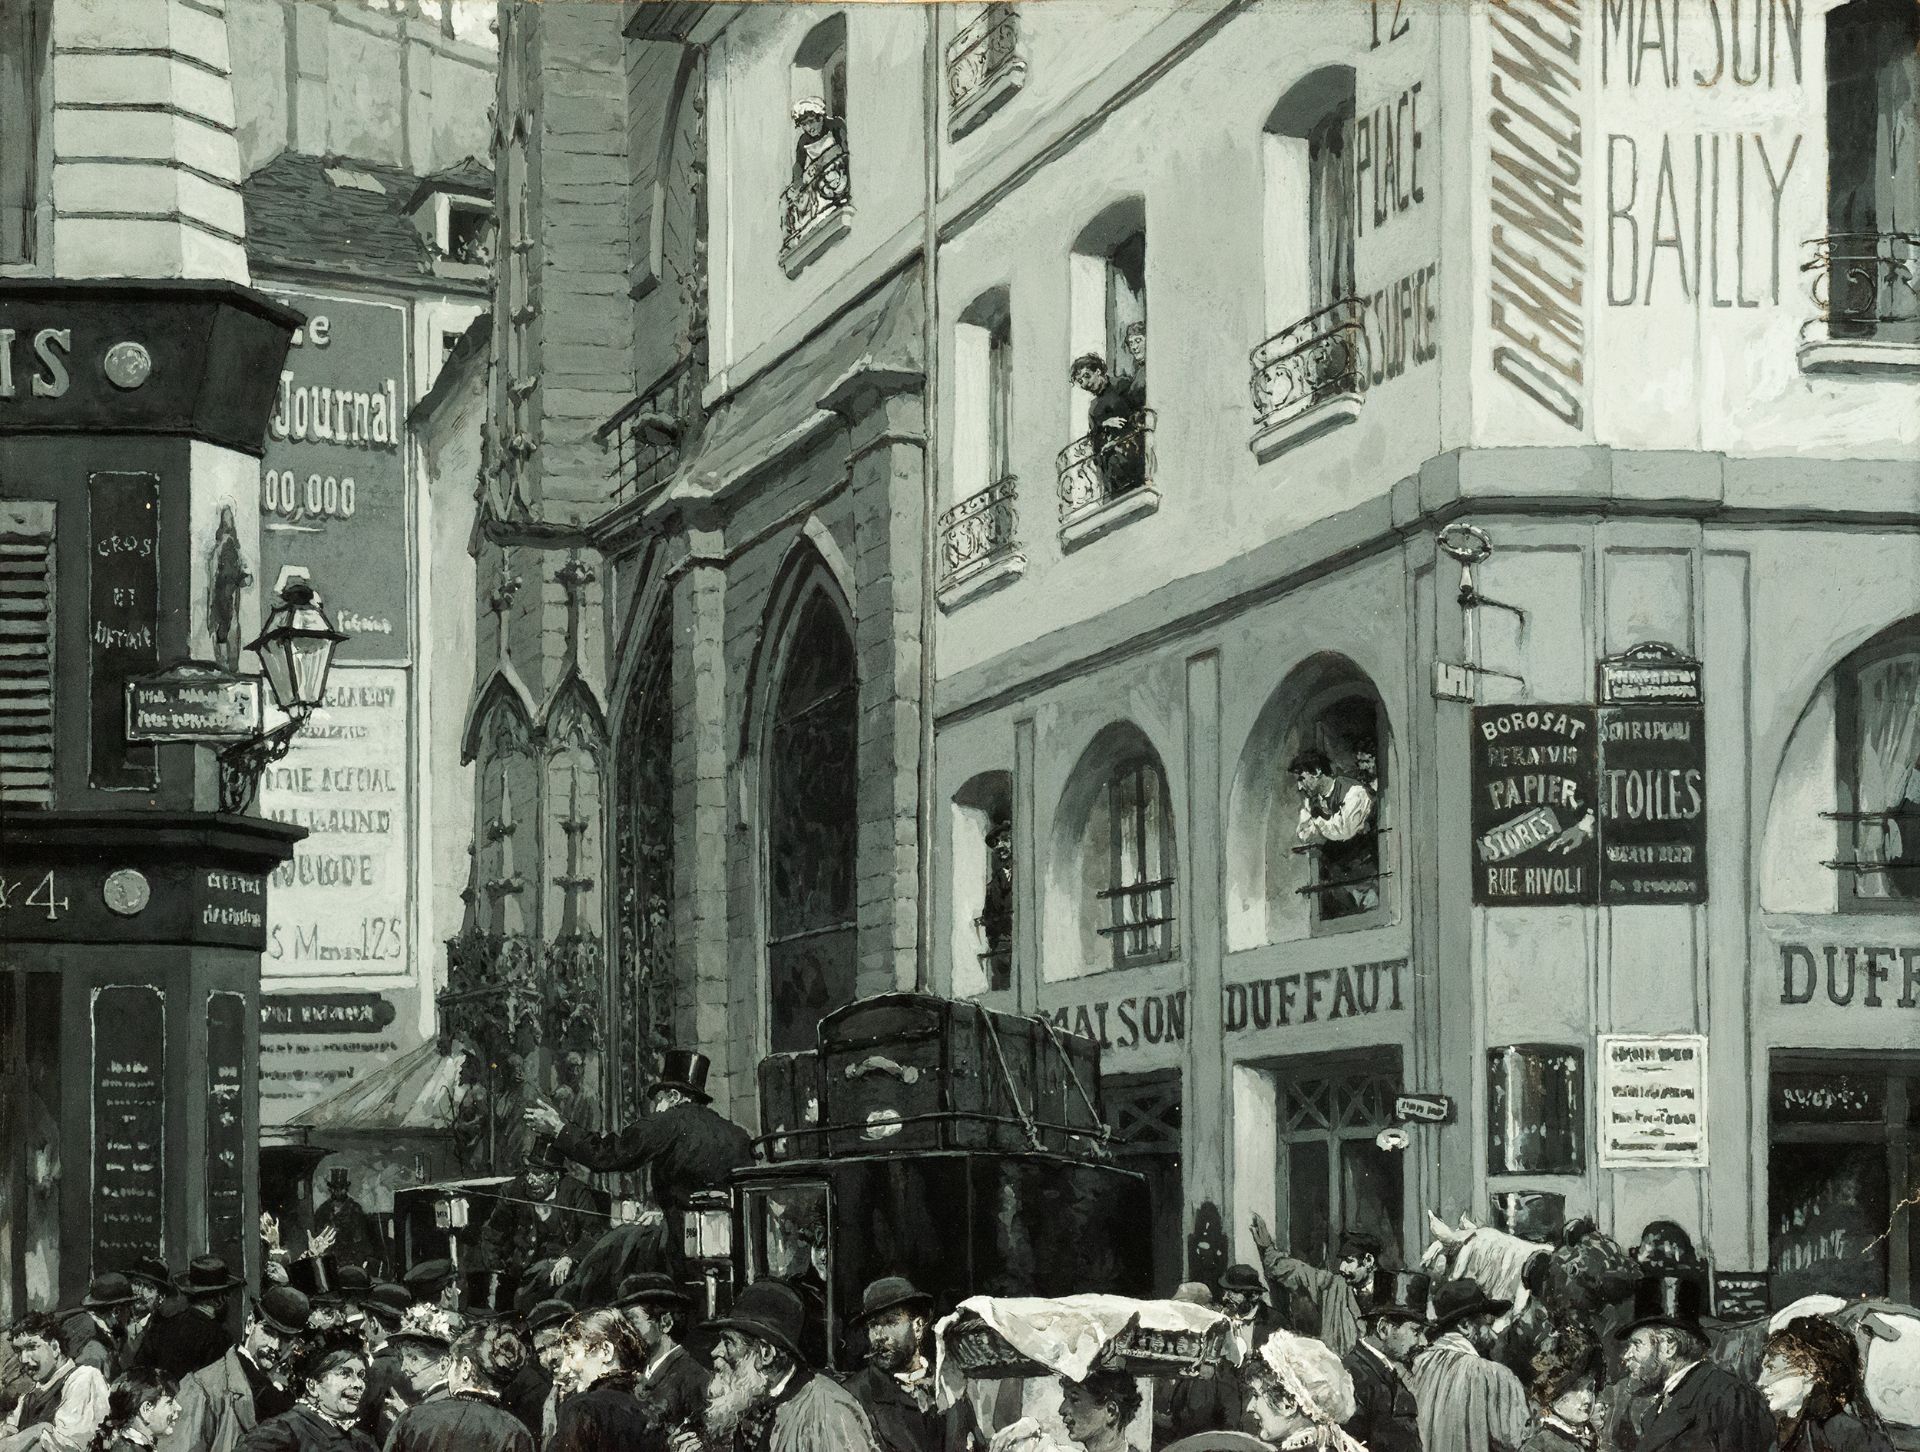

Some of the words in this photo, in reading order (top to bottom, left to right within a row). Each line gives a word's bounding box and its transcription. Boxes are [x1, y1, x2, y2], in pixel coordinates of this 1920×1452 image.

[1606, 132, 1803, 308] BAILLY
[273, 369, 399, 447] Journal
[1481, 711, 1586, 741] BOROSAT
[1489, 774, 1580, 810] PAPIER
[1602, 769, 1702, 821] TOILES
[25, 870, 69, 920] 4
[1488, 867, 1518, 896] RUE
[1525, 866, 1582, 896] RIVOLI
[1223, 958, 1409, 1033] DUFFAUT
